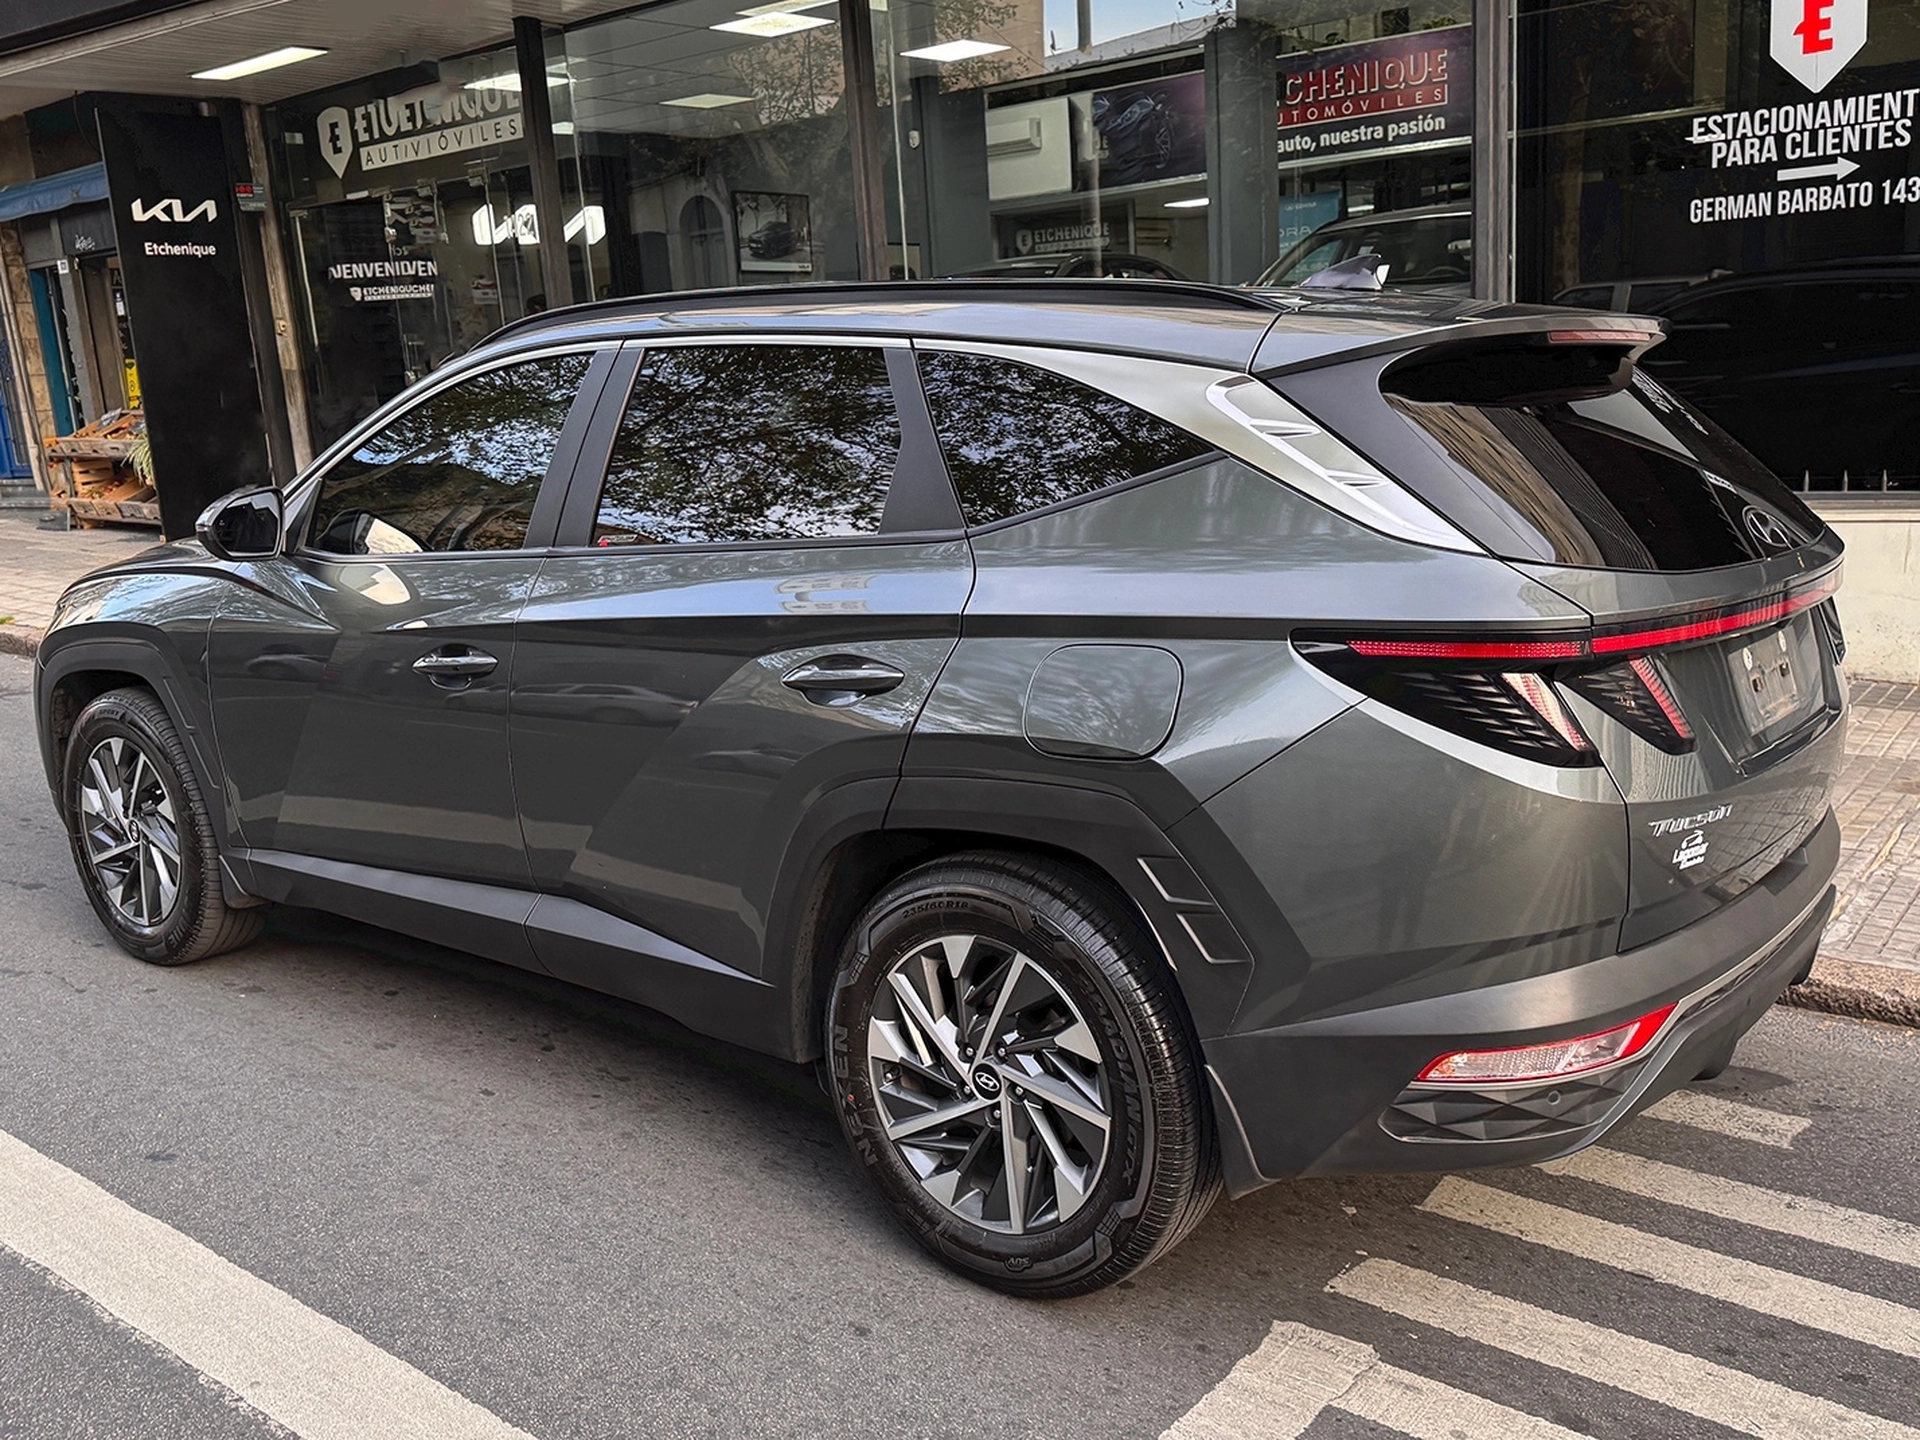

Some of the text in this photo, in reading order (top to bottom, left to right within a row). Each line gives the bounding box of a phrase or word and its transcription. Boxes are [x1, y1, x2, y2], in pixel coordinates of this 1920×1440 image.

[1280, 47, 1448, 106] CHENIQUE
[1320, 125, 1384, 147] nuestra
[1387, 114, 1446, 142] pasión
[1692, 88, 1920, 144] ESTACIONAMIENT
[1711, 118, 1912, 169] PARA CLIENTES
[131, 198, 218, 223] KIA
[1689, 191, 1772, 224] GERMAN
[1777, 181, 1874, 215] BARBATO
[143, 242, 217, 259] Etchenique
